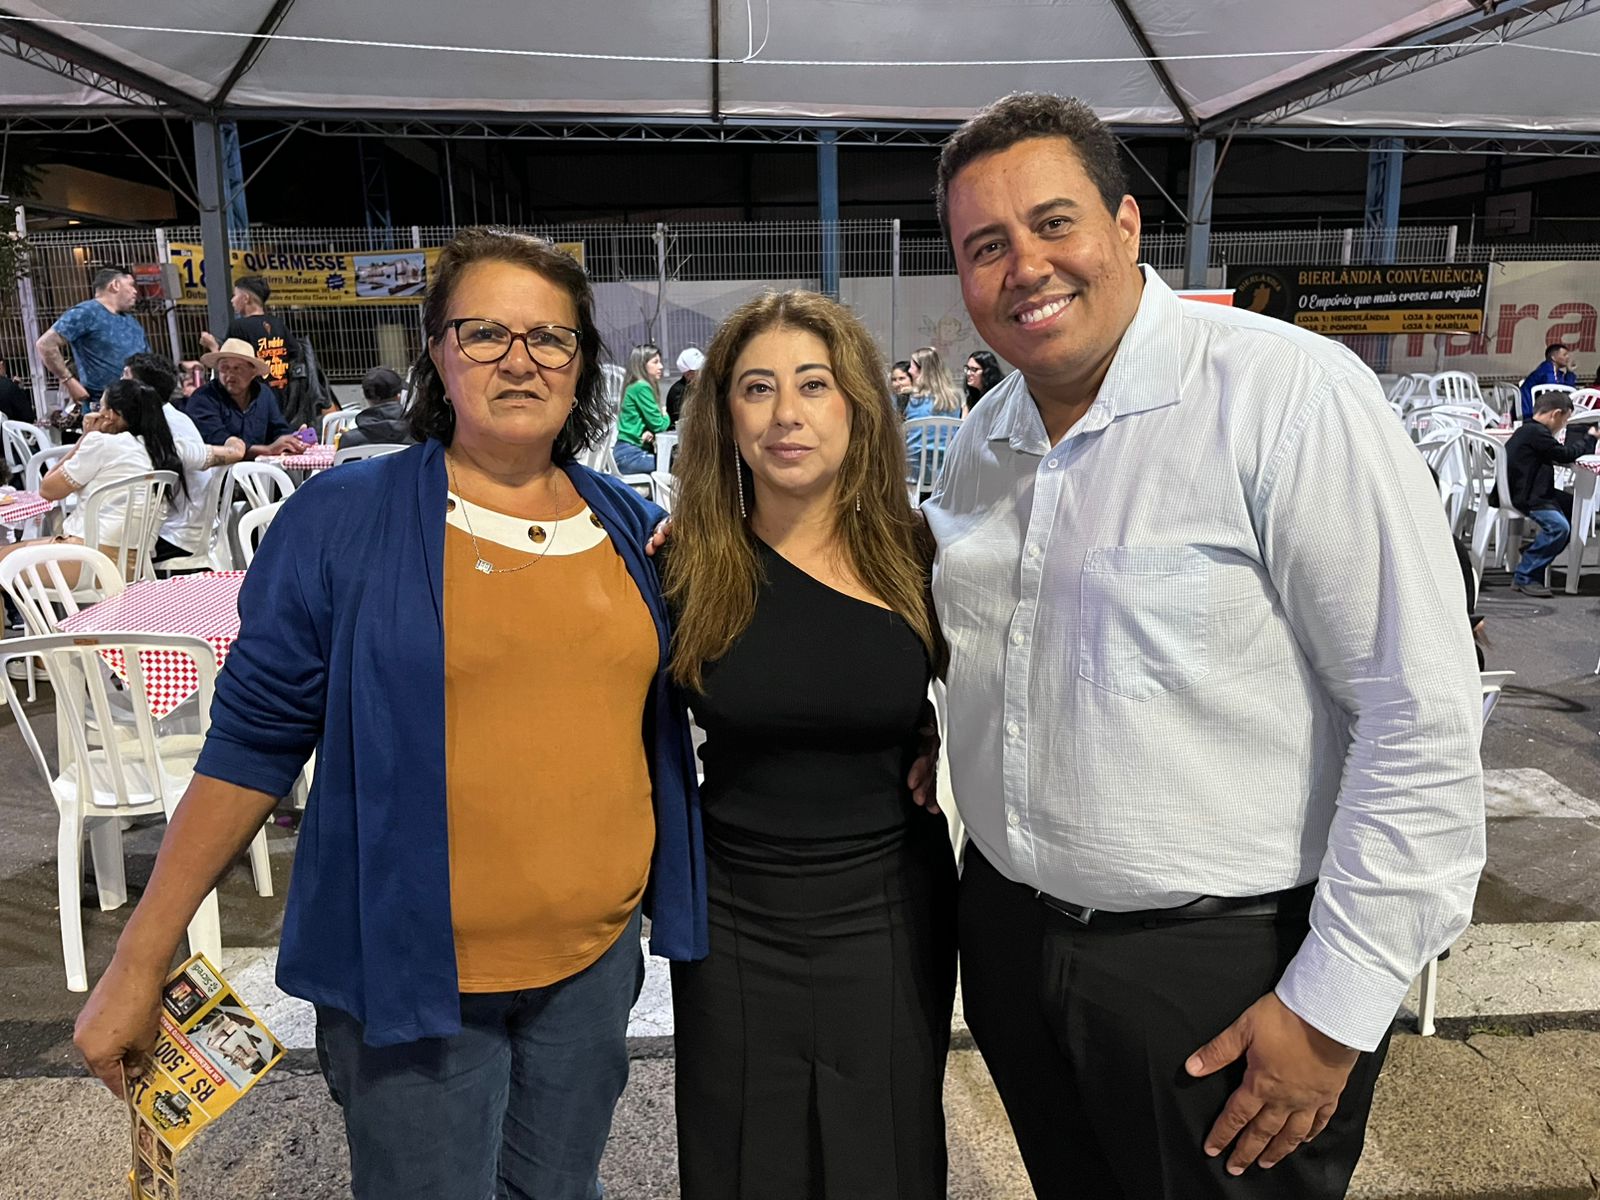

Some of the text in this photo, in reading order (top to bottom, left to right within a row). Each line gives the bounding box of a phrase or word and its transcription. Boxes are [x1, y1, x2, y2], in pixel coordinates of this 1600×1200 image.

[244, 253, 347, 271] QUERMESSE
[1298, 266, 1484, 285] BIERLÂNDIA CONVENIÊNCIA
[1298, 284, 1482, 311] O Empório que mais cresce na região!
[1297, 315, 1319, 323] LOJA
[1435, 313, 1478, 321] QUINTANA
[1330, 323, 1368, 331] POMPEIA
[191, 963, 212, 986] Sicredi
[153, 1030, 197, 1086] 7.500,
[190, 1077, 217, 1104] R$
